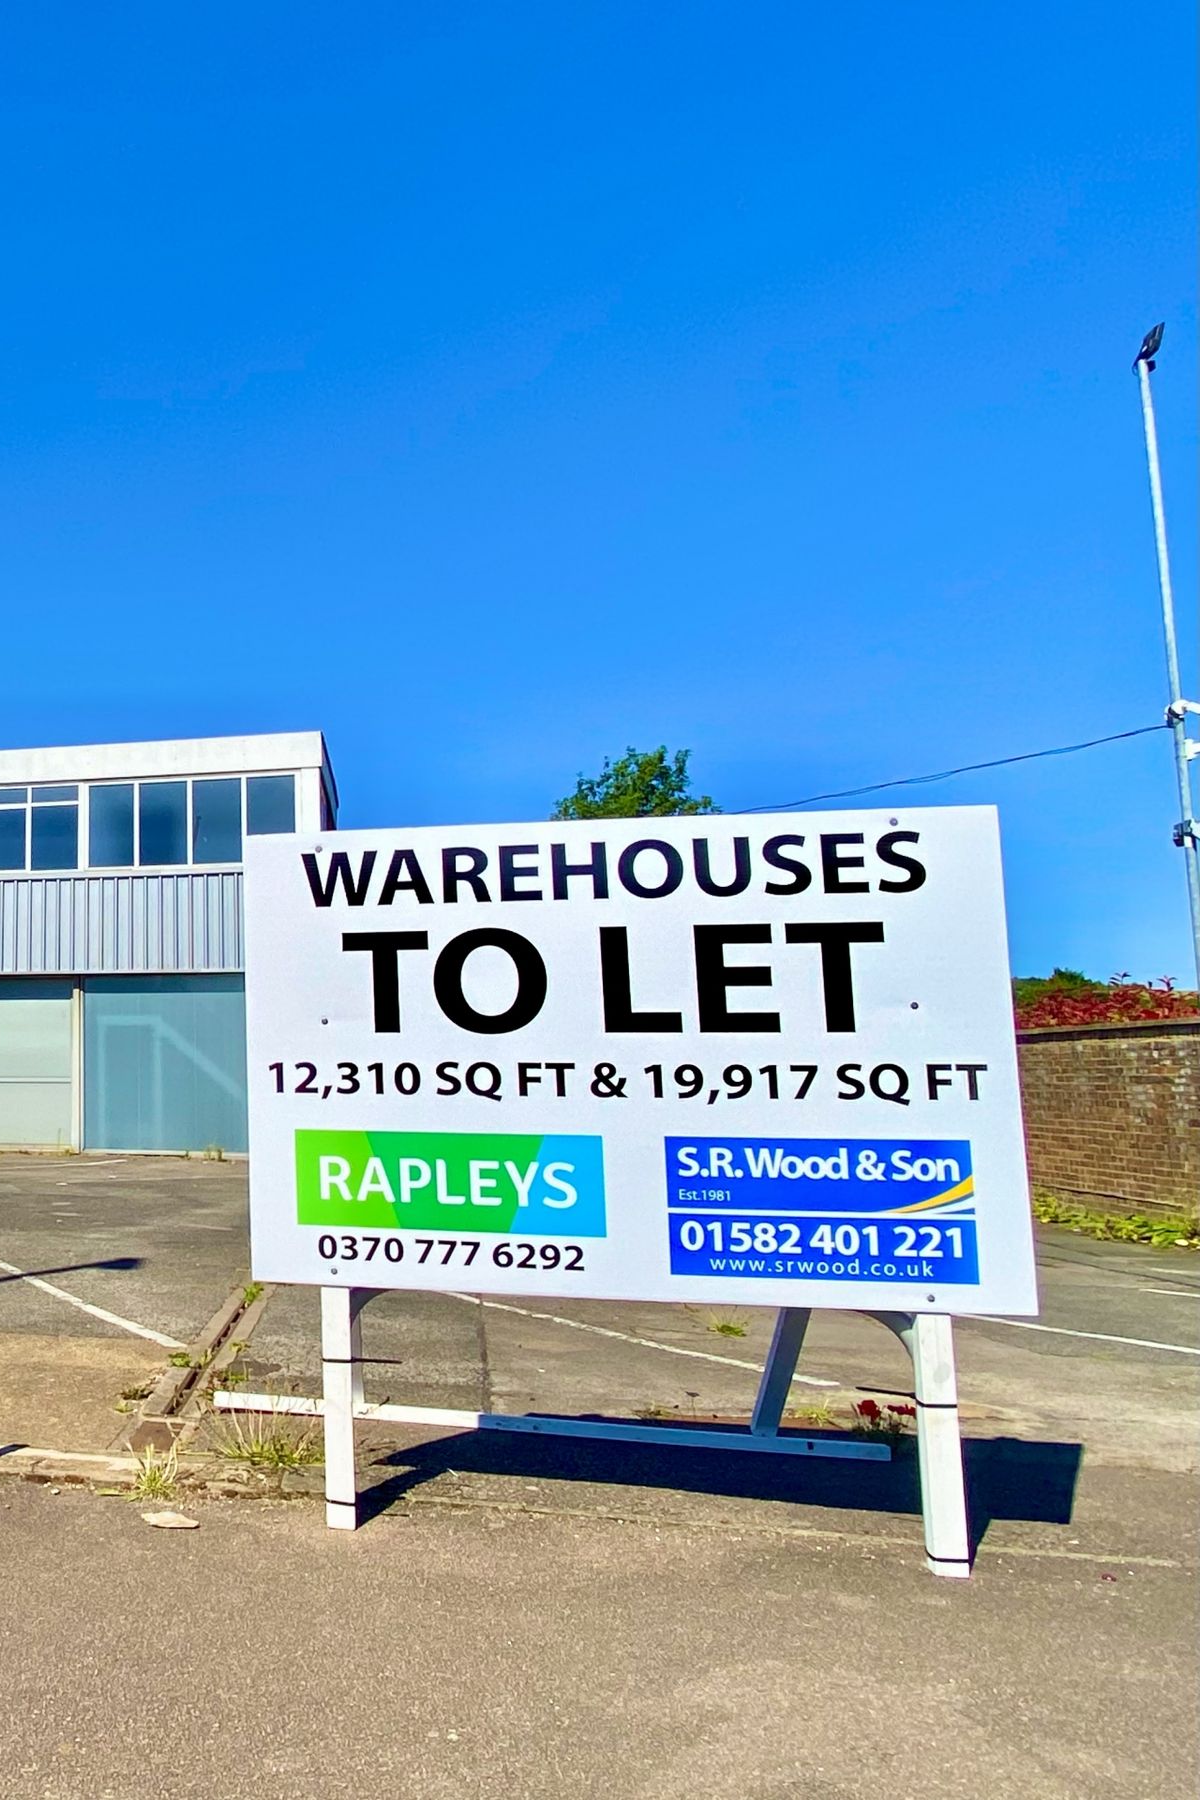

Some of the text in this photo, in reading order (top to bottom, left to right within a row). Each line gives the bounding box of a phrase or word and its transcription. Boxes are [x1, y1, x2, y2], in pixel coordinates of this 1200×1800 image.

[301, 831, 927, 908] WAREHOUSES
[342, 921, 885, 1035] TO LET
[268, 1061, 988, 1106] 12,310 SQ FT & 19,917 SQ FT
[318, 1155, 578, 1209] RAPLEYS
[855, 1149, 887, 1181] &
[890, 1150, 961, 1182] Son
[318, 1234, 585, 1271] 0370 777 6292
[679, 1220, 963, 1258] 01582 401 221
[709, 1257, 934, 1278] www.srwood.co.uk
